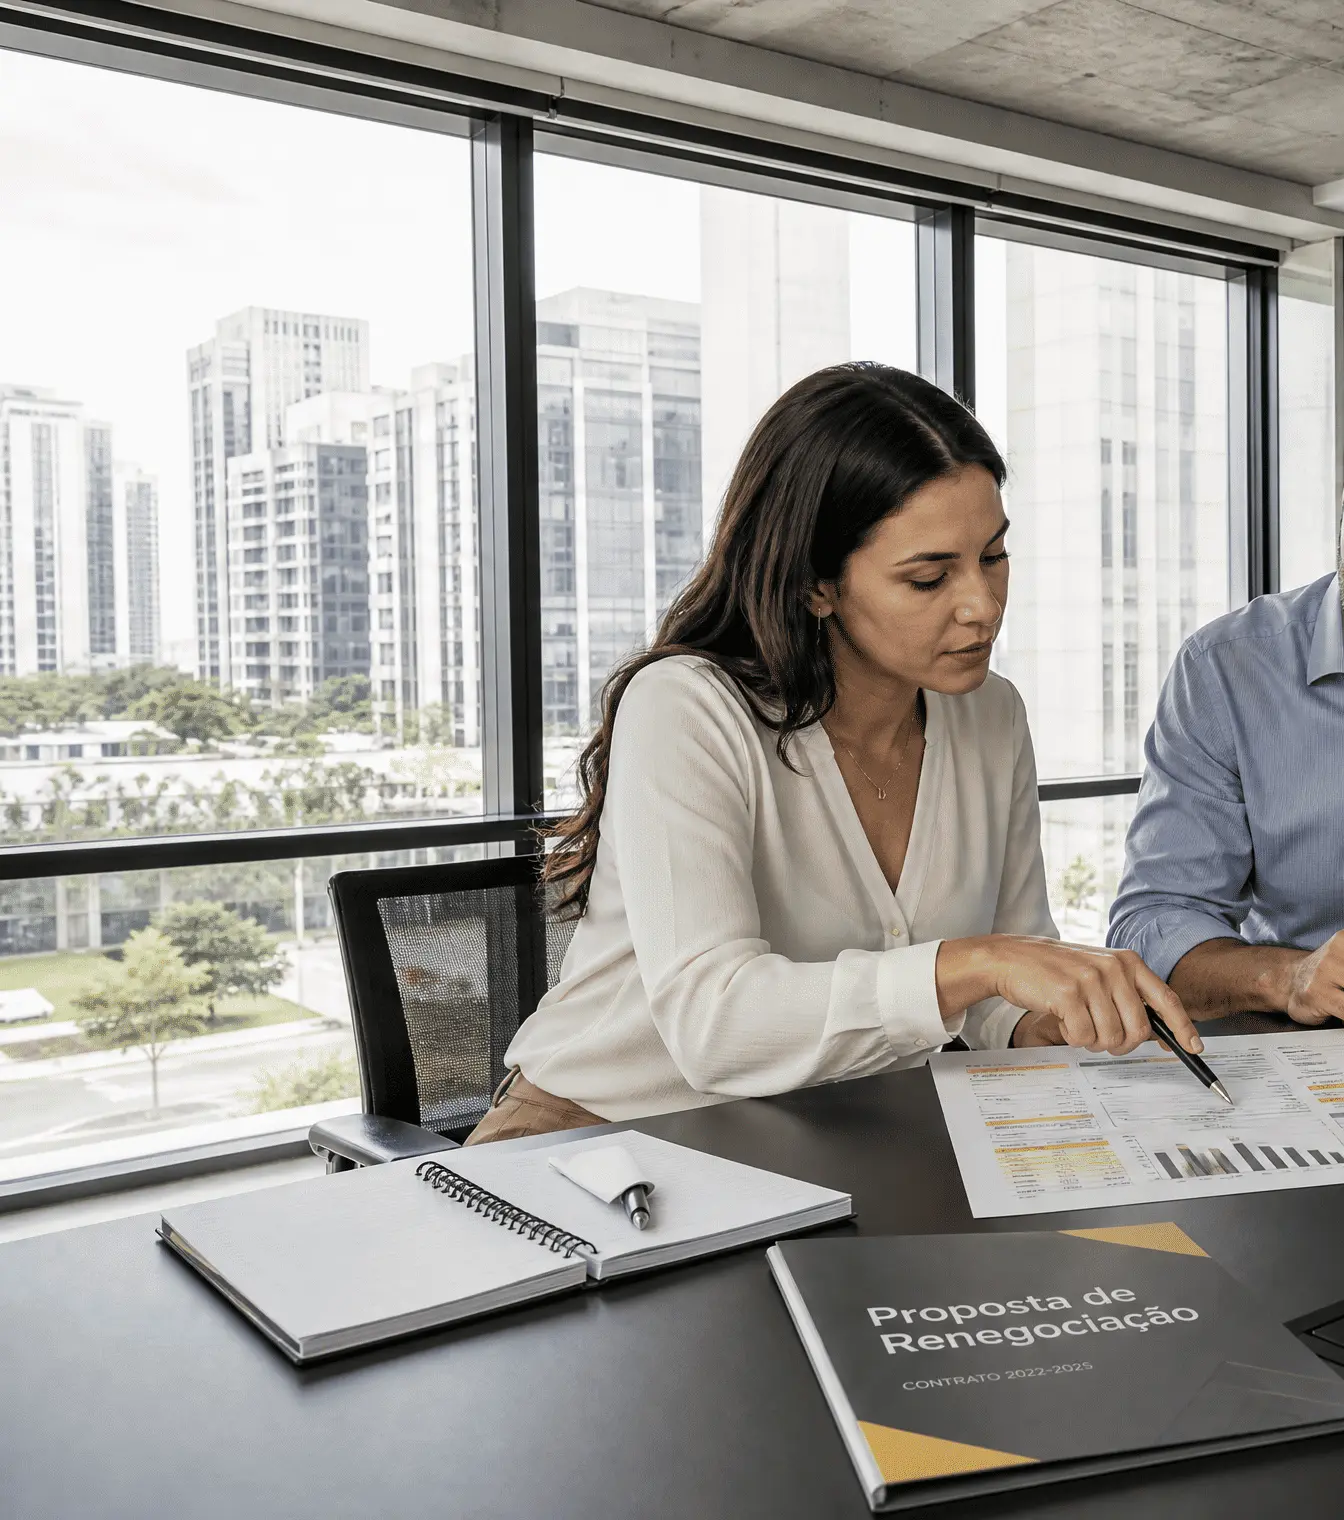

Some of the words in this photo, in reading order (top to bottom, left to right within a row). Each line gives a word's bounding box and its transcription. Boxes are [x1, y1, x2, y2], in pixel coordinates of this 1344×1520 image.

[866, 1294, 1073, 1327] Proposta
[1082, 1286, 1137, 1306] de
[879, 1304, 1200, 1355] Renegociação
[902, 1372, 1001, 1391] CONTRATO
[1004, 1361, 1094, 1380] 2022-2025
